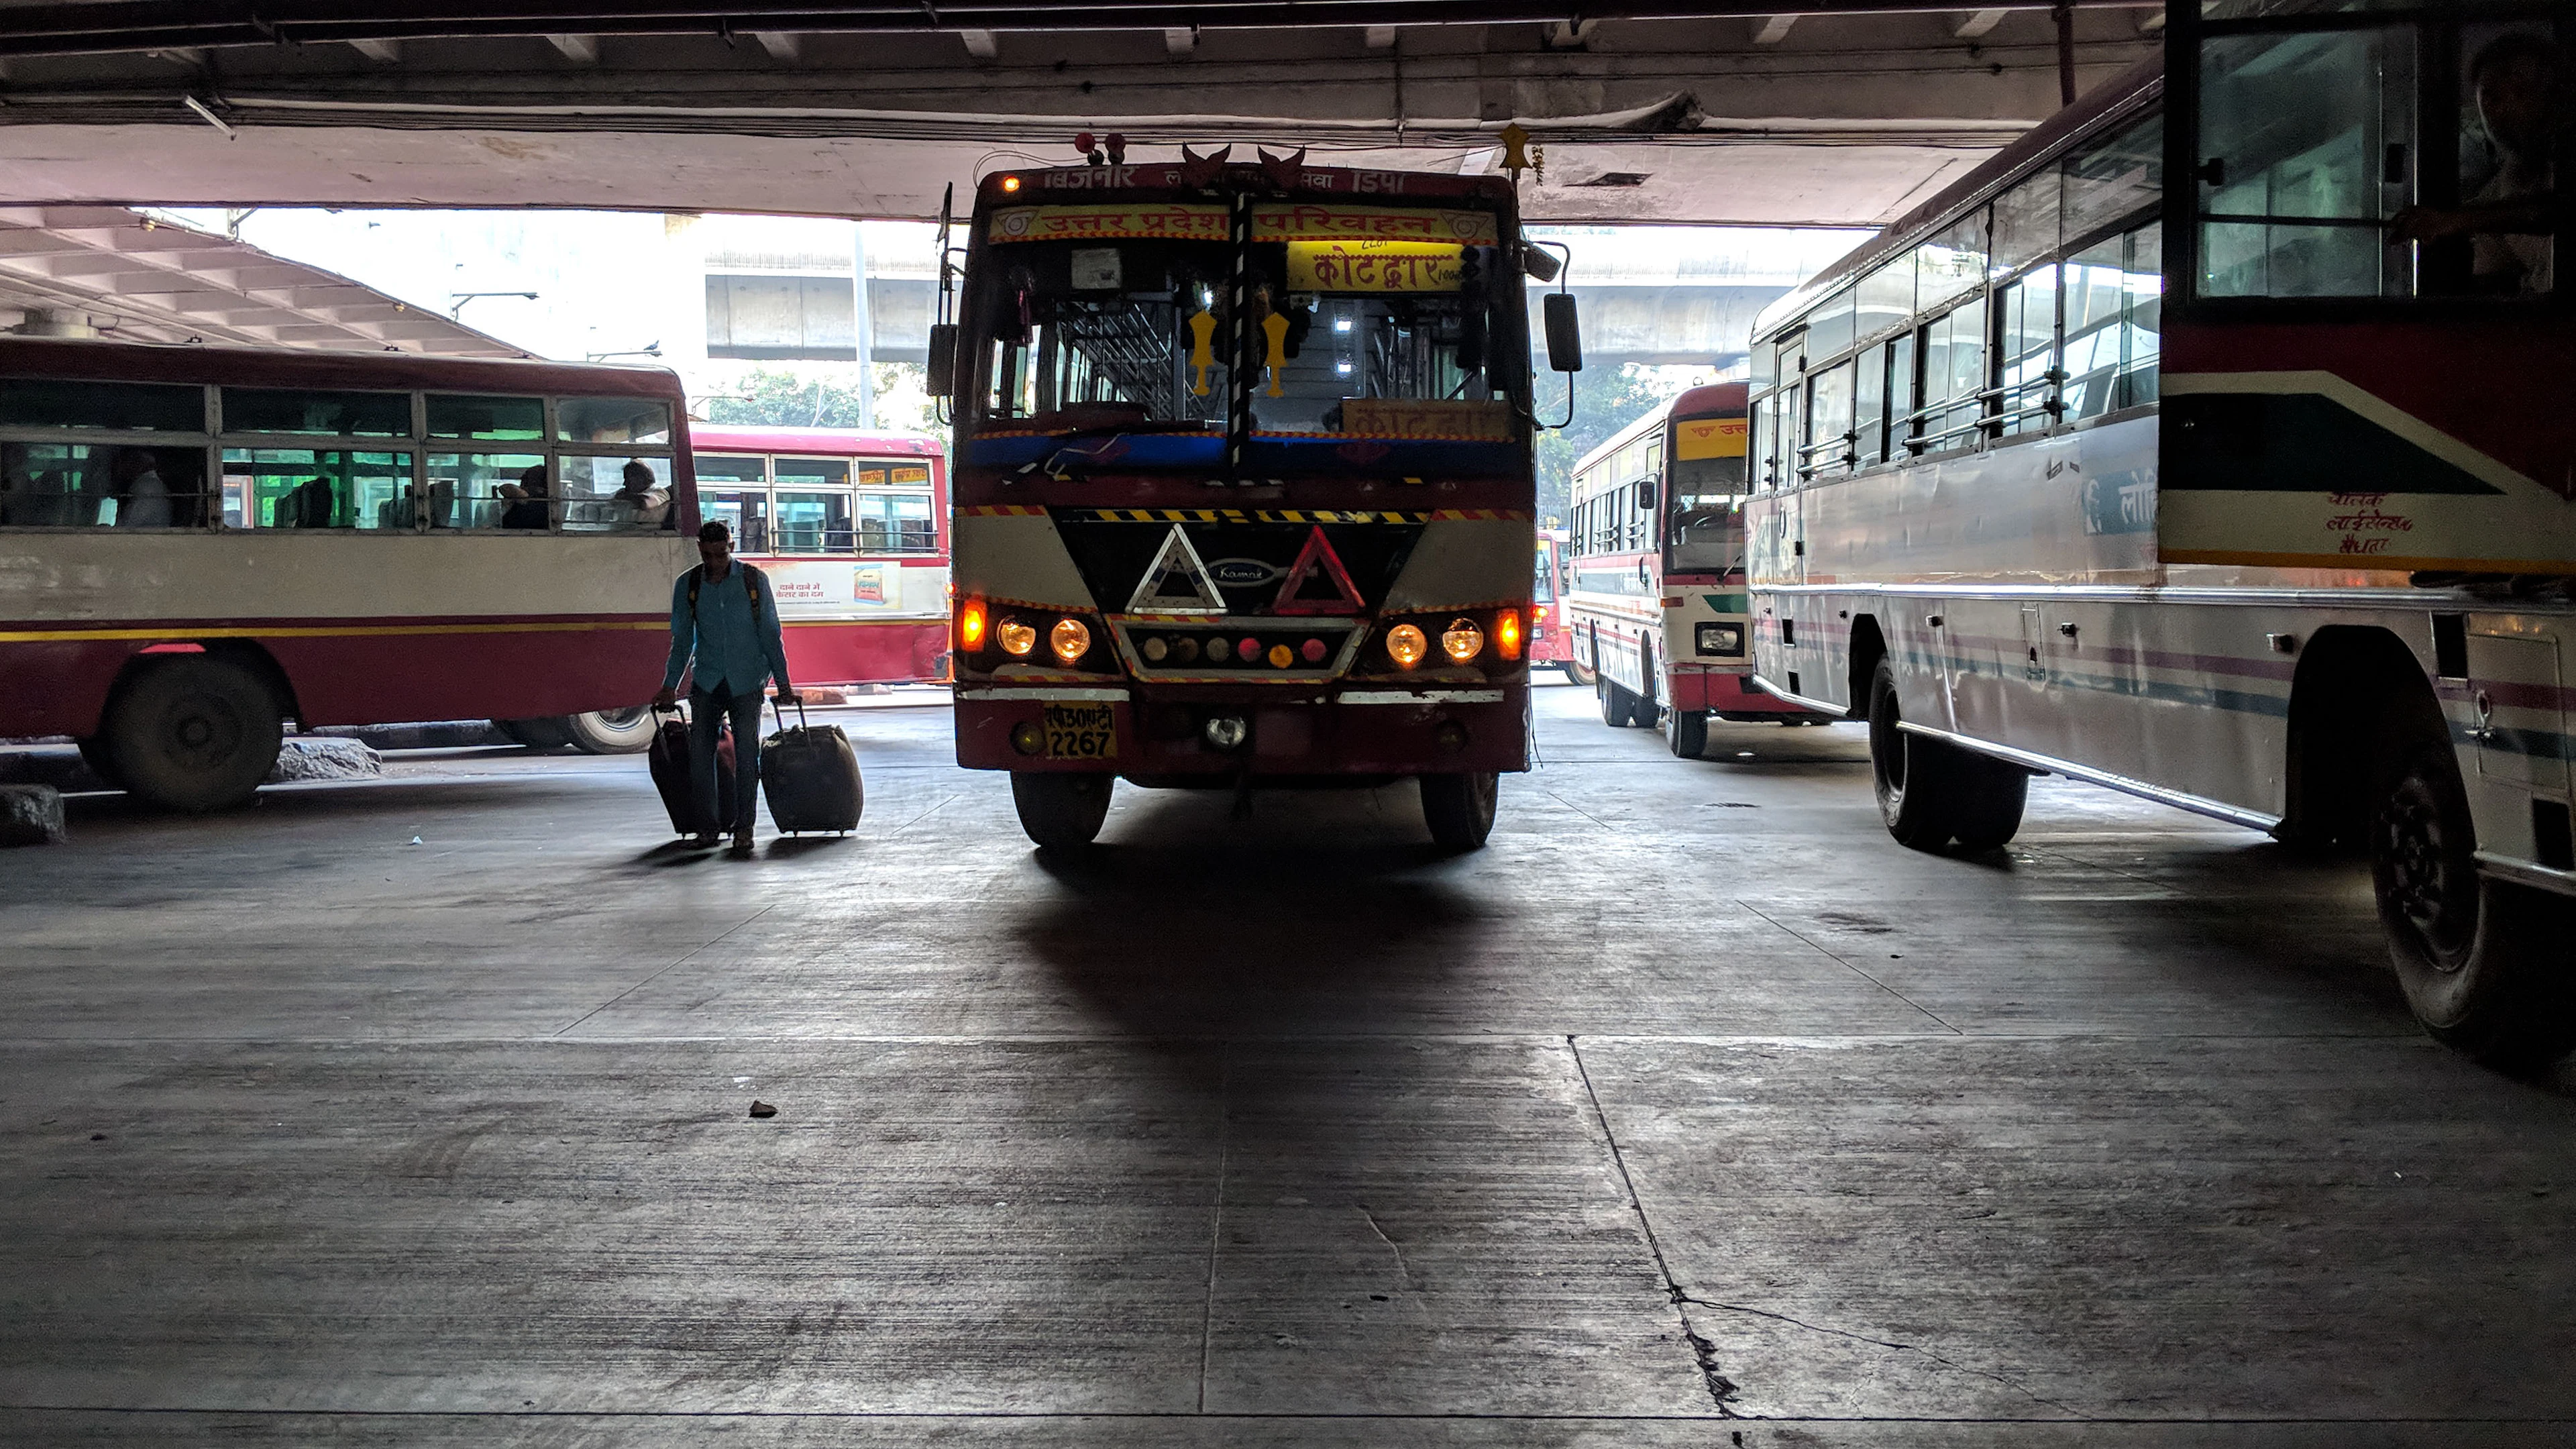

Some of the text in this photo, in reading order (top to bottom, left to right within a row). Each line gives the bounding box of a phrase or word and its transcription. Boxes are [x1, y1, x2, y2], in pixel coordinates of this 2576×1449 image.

[1041, 205, 1438, 235] उत्तर प्रदेश परिवहन
[1051, 731, 1110, 756] 2267
